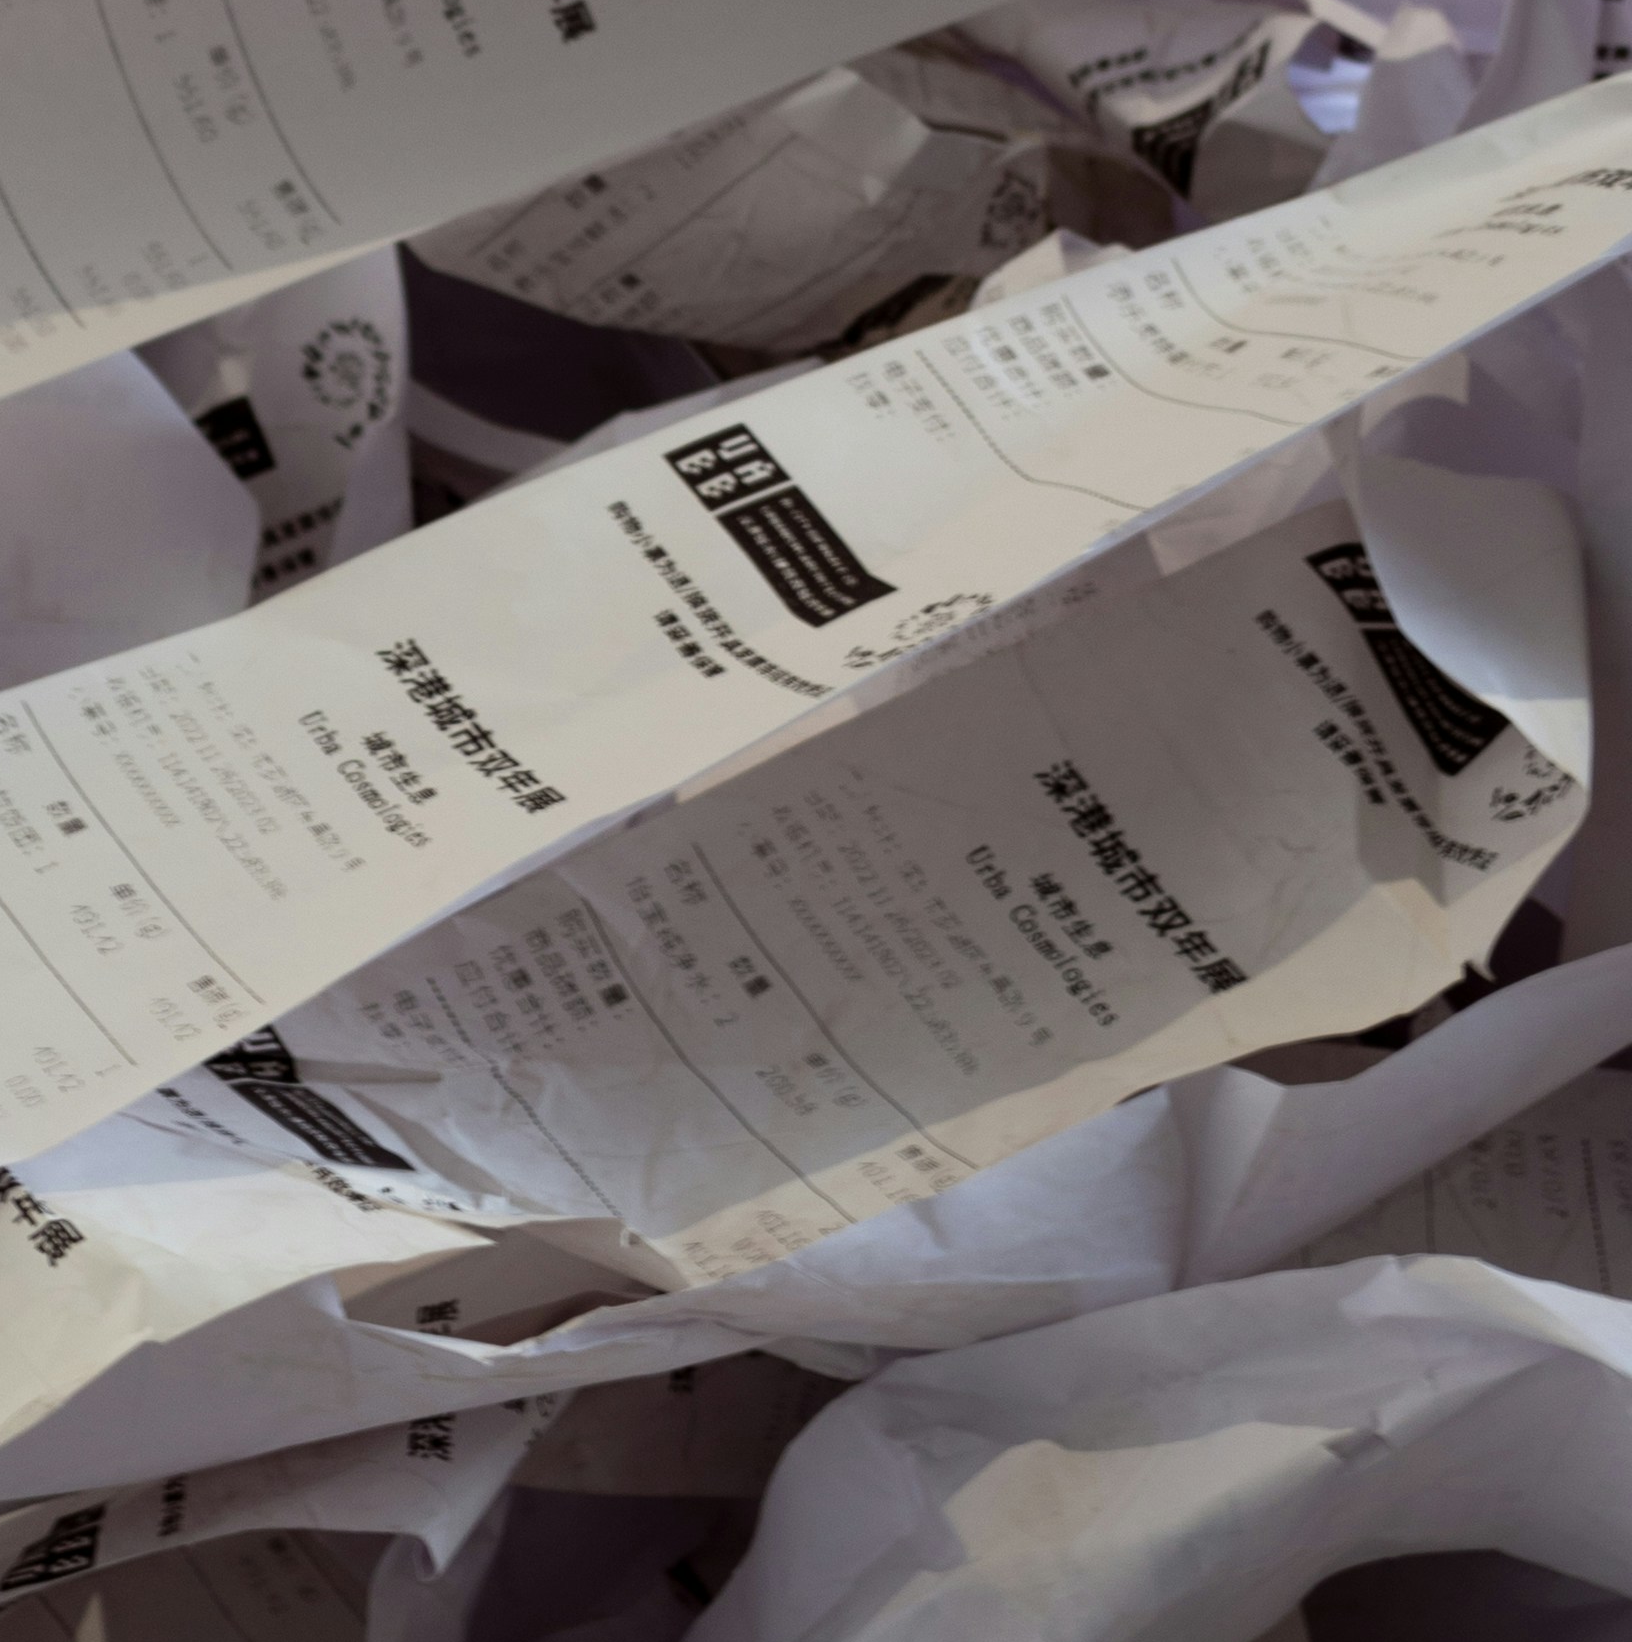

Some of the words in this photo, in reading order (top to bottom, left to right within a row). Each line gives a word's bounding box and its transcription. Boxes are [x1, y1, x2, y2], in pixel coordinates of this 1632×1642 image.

[296, 707, 350, 757] Urba
[333, 755, 436, 851] Cosmologies
[356, 728, 442, 808] 城市生息
[371, 634, 569, 817] 深港城市双年展
[959, 842, 1019, 901] Urba
[1004, 898, 1124, 1031] Cosmologies
[1024, 866, 1114, 962] 城市生息
[1031, 754, 1250, 1000] 深港城市双年展
